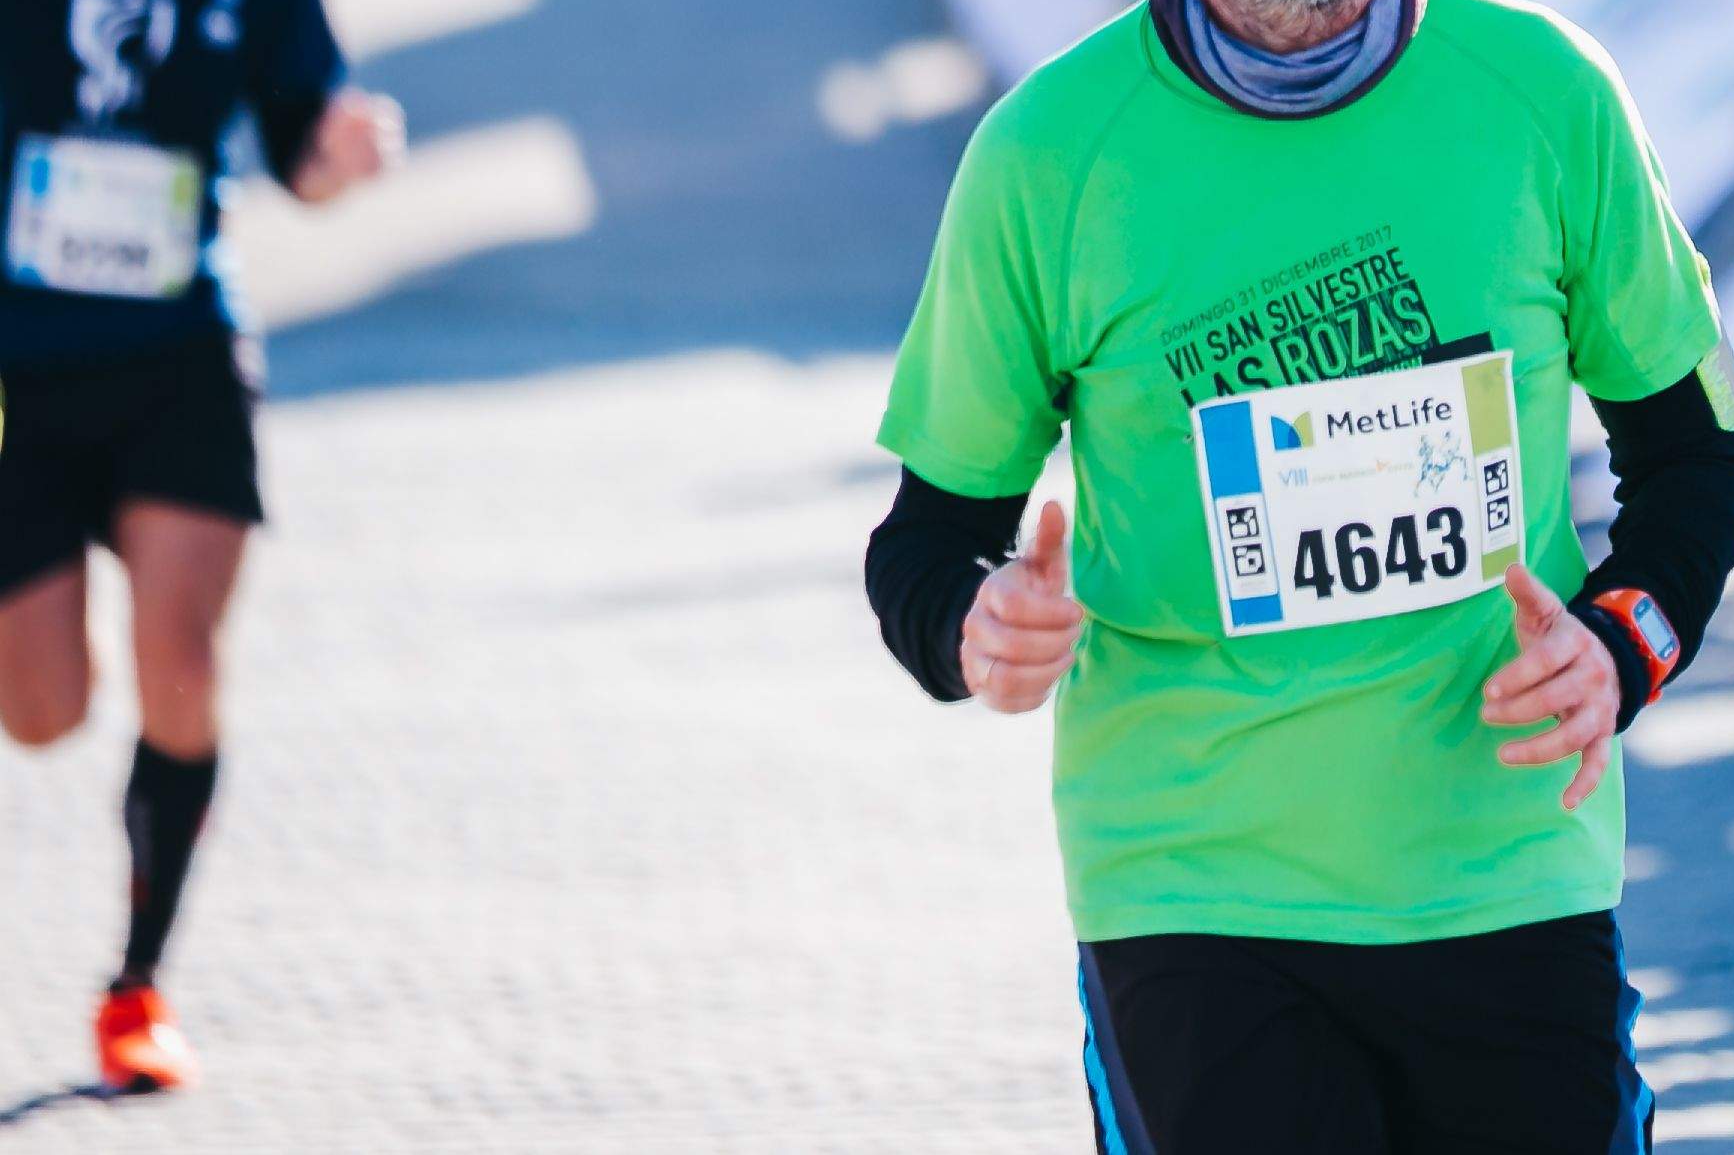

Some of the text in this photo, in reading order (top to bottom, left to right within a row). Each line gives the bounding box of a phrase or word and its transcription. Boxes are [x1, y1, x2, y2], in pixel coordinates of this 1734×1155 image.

[1159, 225, 1394, 345] DOMINGO 31 DICIEMBRE 2017
[1165, 247, 1411, 383] VII SAN SILVESTRE
[1275, 287, 1433, 387] ROZAS
[1326, 397, 1453, 440] MetLife
[1293, 505, 1469, 601] 4643
